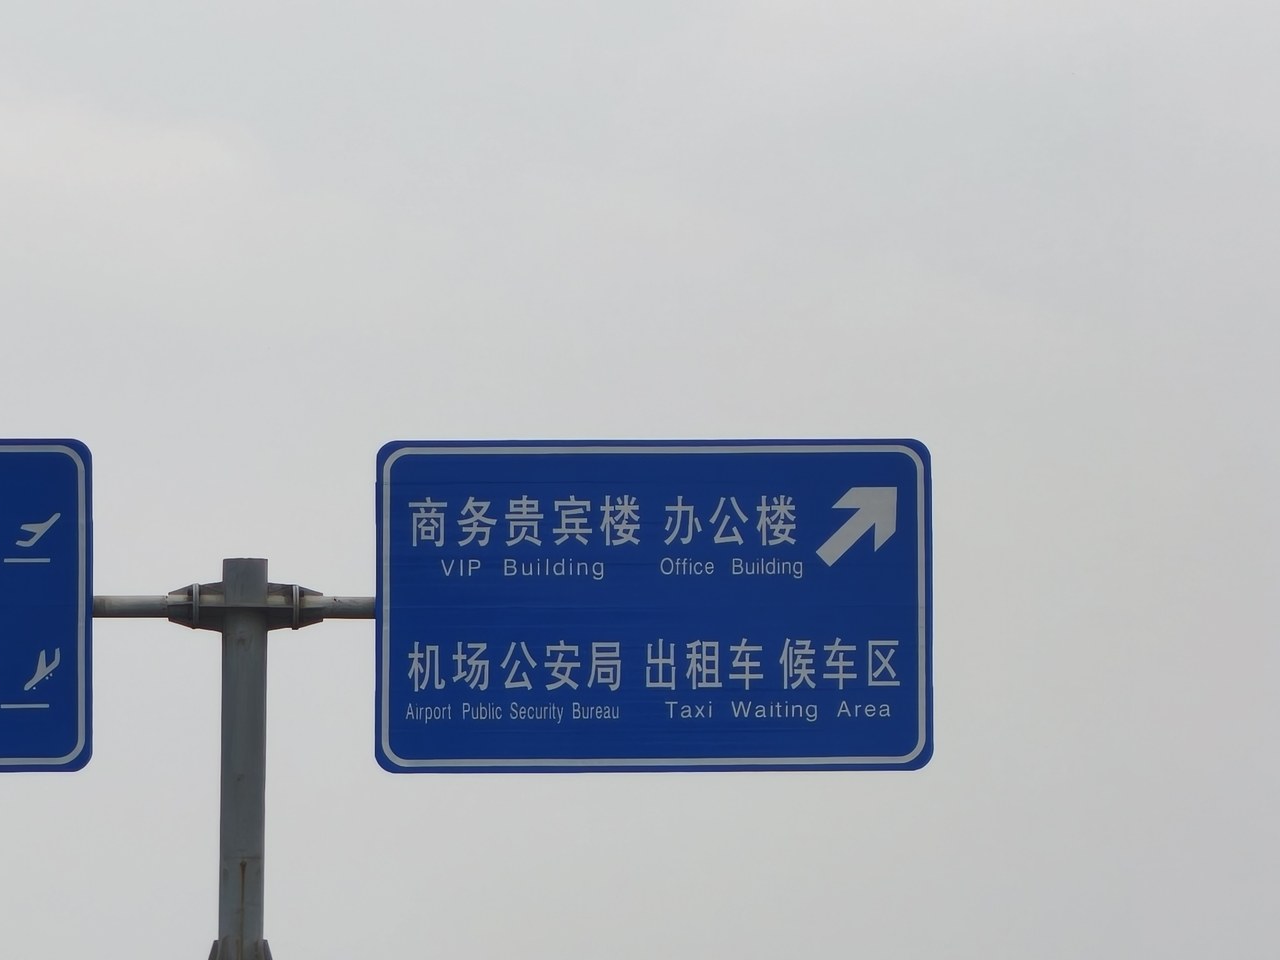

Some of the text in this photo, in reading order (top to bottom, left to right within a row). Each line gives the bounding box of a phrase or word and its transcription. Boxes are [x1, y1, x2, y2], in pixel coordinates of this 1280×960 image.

[408, 494, 641, 548] 商务贵宾楼
[664, 494, 797, 547] 办公楼
[441, 558, 605, 580] VIP Building
[660, 557, 803, 579] Office Building
[407, 639, 622, 692] 机场公安局
[645, 637, 901, 691] 出租车 候车区
[405, 701, 620, 724] Airport Public Security Bureau
[664, 700, 891, 722] Taxi Waiting Area
